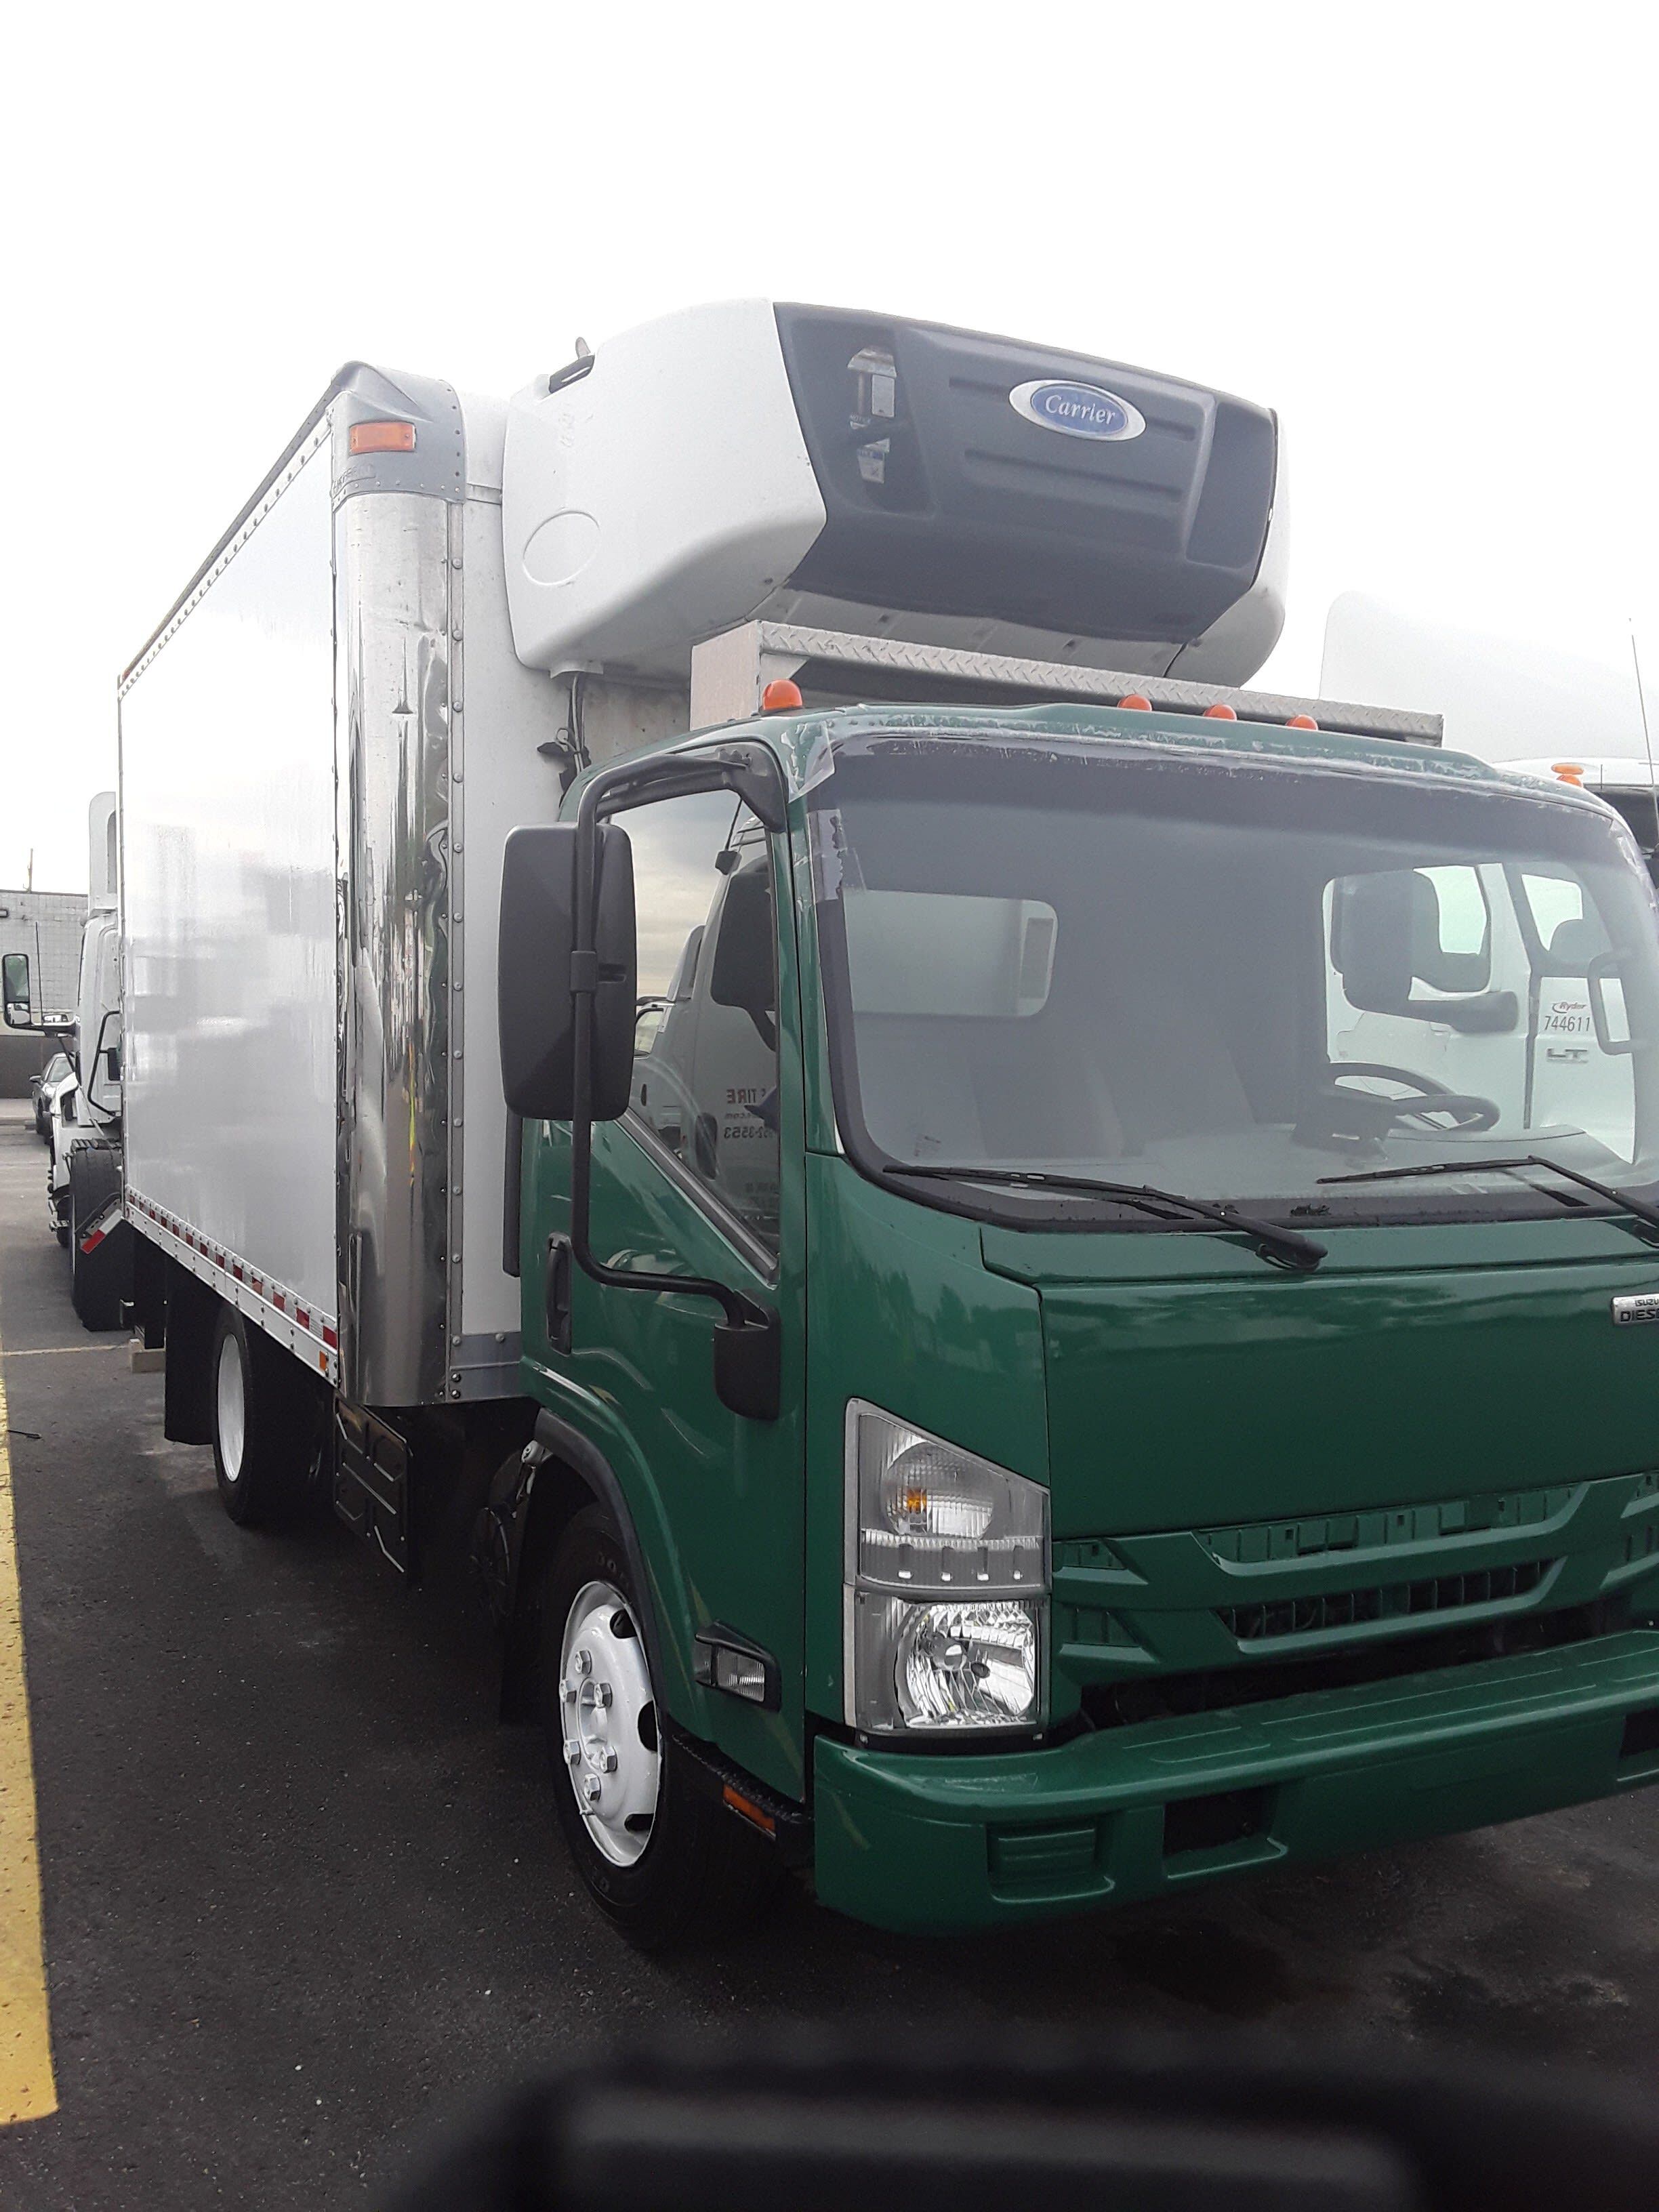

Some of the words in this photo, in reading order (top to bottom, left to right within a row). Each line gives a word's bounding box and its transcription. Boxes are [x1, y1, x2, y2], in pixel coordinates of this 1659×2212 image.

[1045, 395, 1115, 425] Carrier
[1557, 1002, 1587, 1012] Ryder
[1544, 1015, 1591, 1032] 744611
